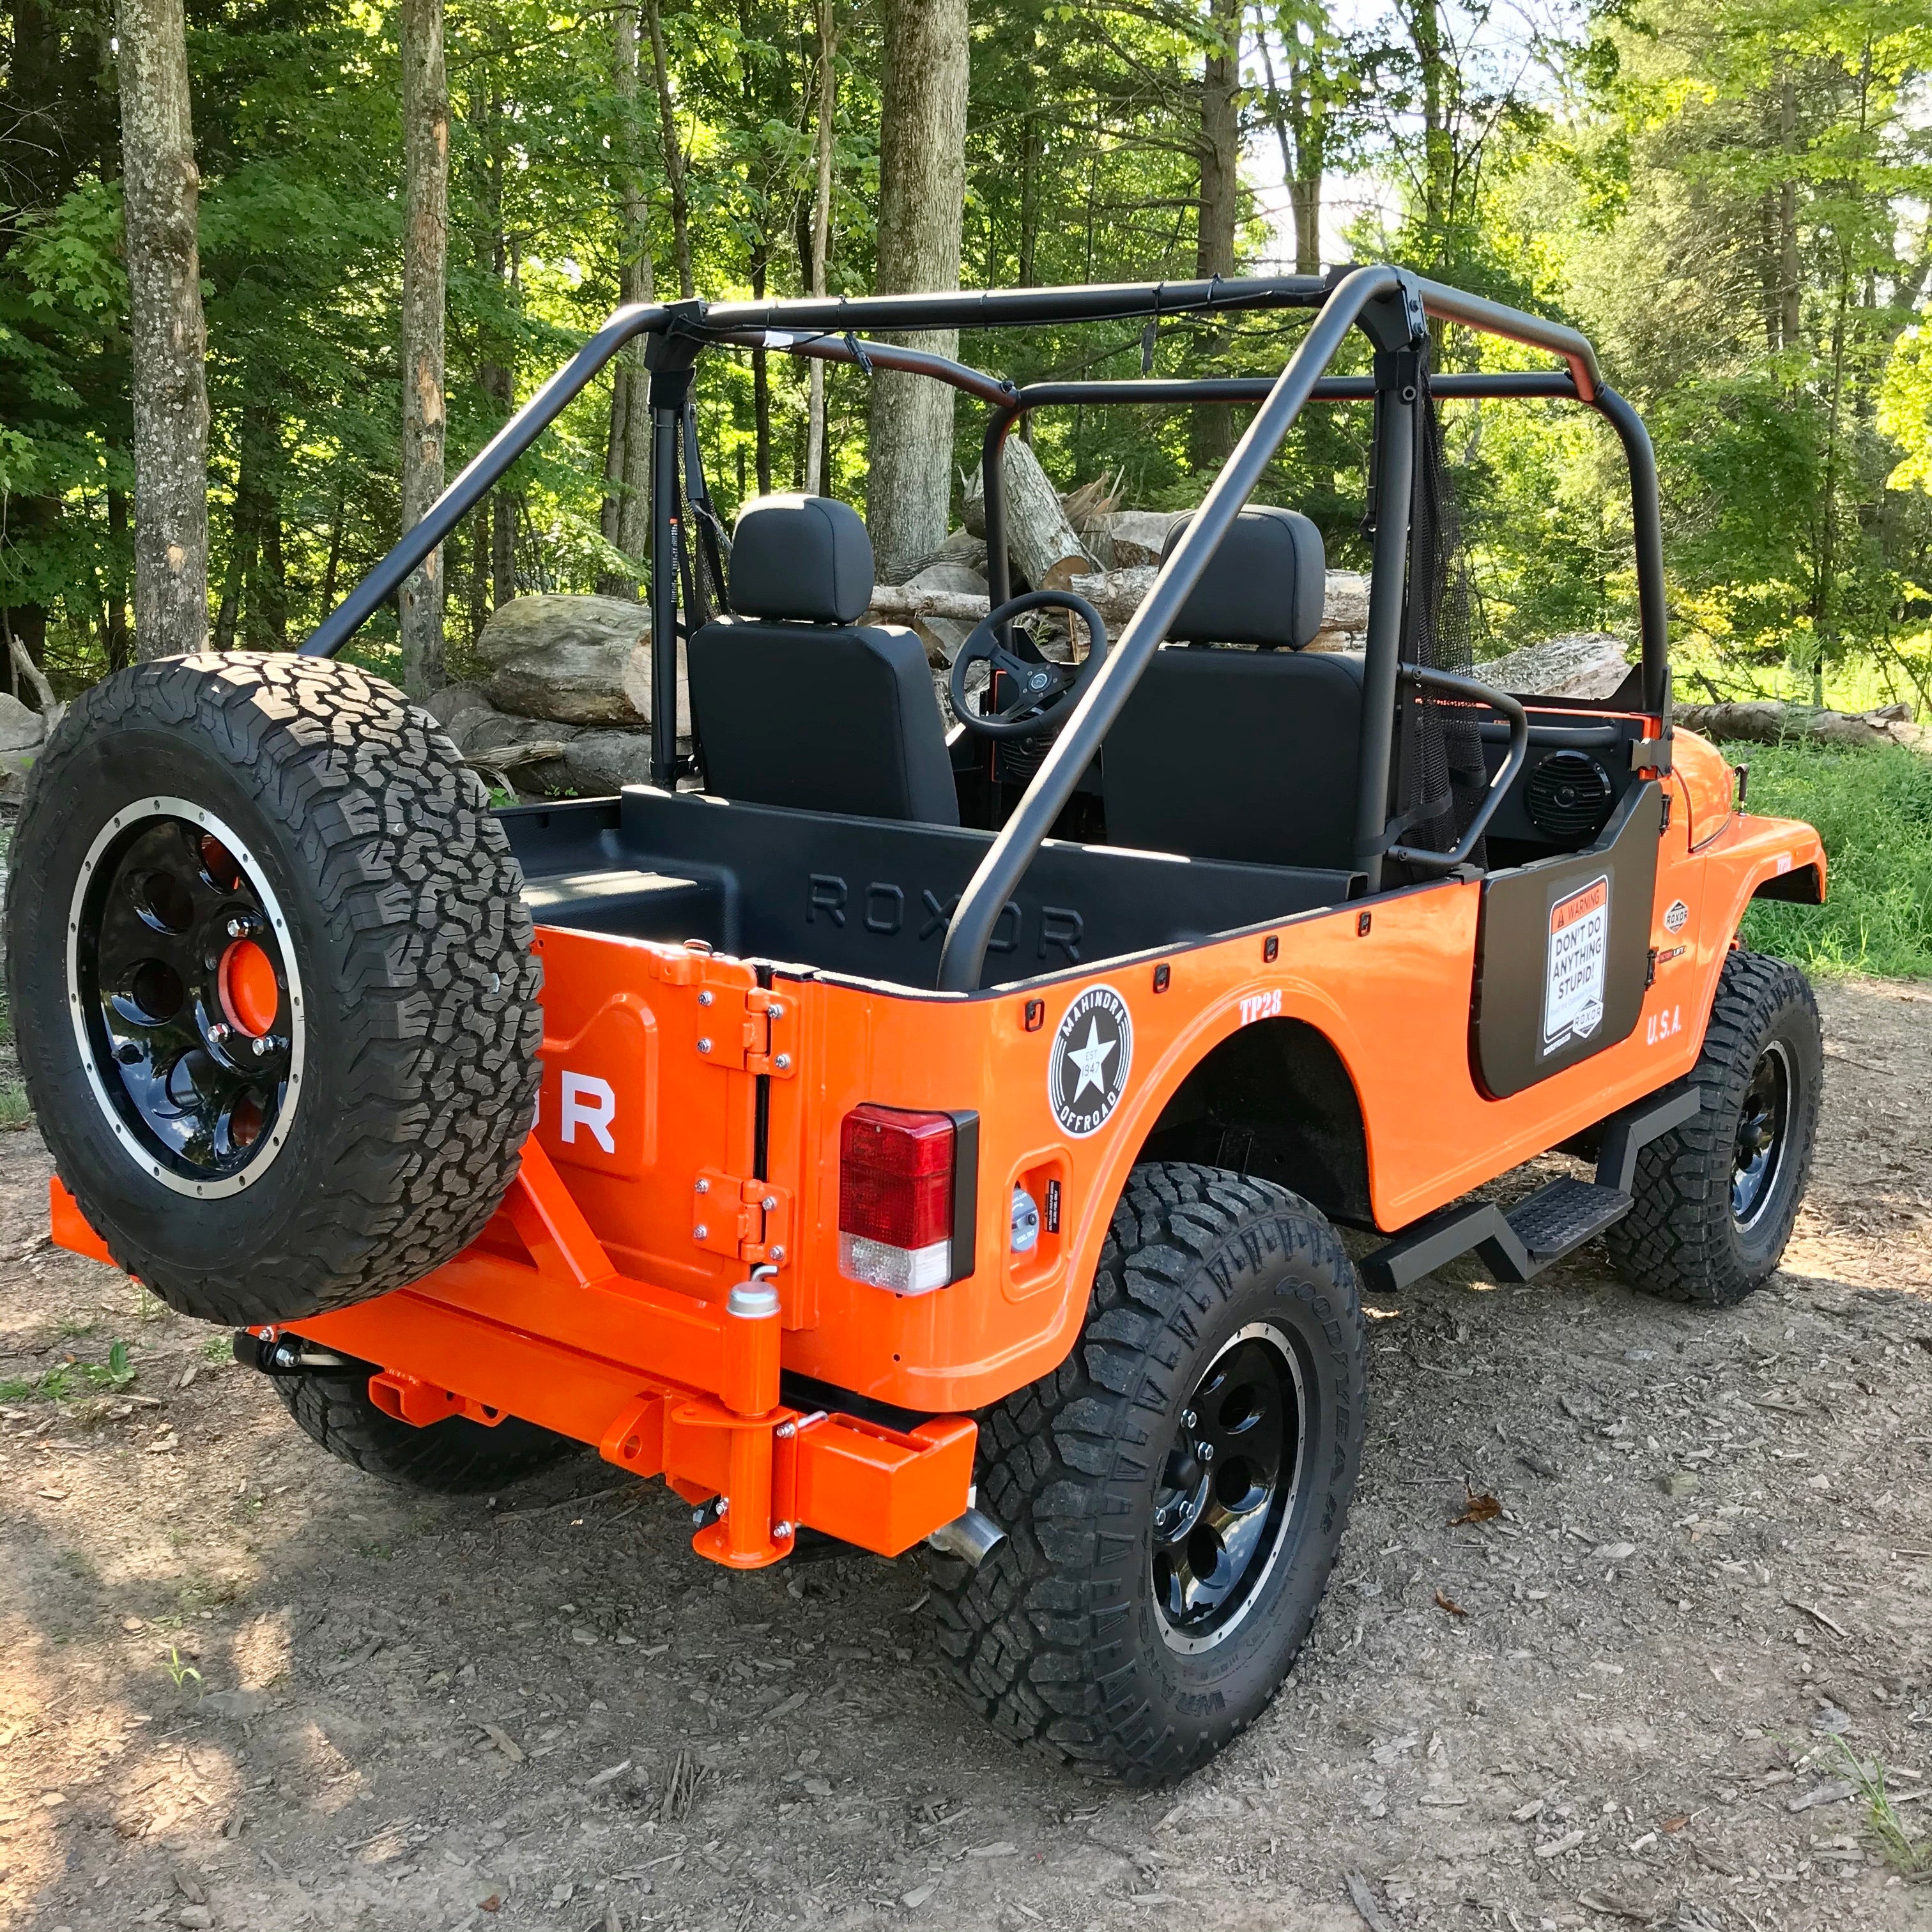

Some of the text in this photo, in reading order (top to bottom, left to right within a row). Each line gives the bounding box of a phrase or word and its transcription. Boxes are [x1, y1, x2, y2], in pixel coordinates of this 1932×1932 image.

[1568, 889, 1600, 921] WARNING
[1666, 910, 1687, 925] ROXOR
[1556, 916, 1600, 957] DON'T DO
[1552, 937, 1601, 982] ANYTHING
[1558, 962, 1595, 1000] STUPID!
[1062, 991, 1124, 1037] MAHINDRA
[1239, 988, 1282, 1027] TP28
[1574, 1007, 1601, 1028] ROXOR
[1647, 1004, 1682, 1045] U.S.A.
[1082, 1061, 1100, 1078] 1947
[1085, 1049, 1098, 1061] EST
[1061, 1091, 1116, 1131] OFFROAD
[1274, 1275, 1350, 1536] GOODYEAR
